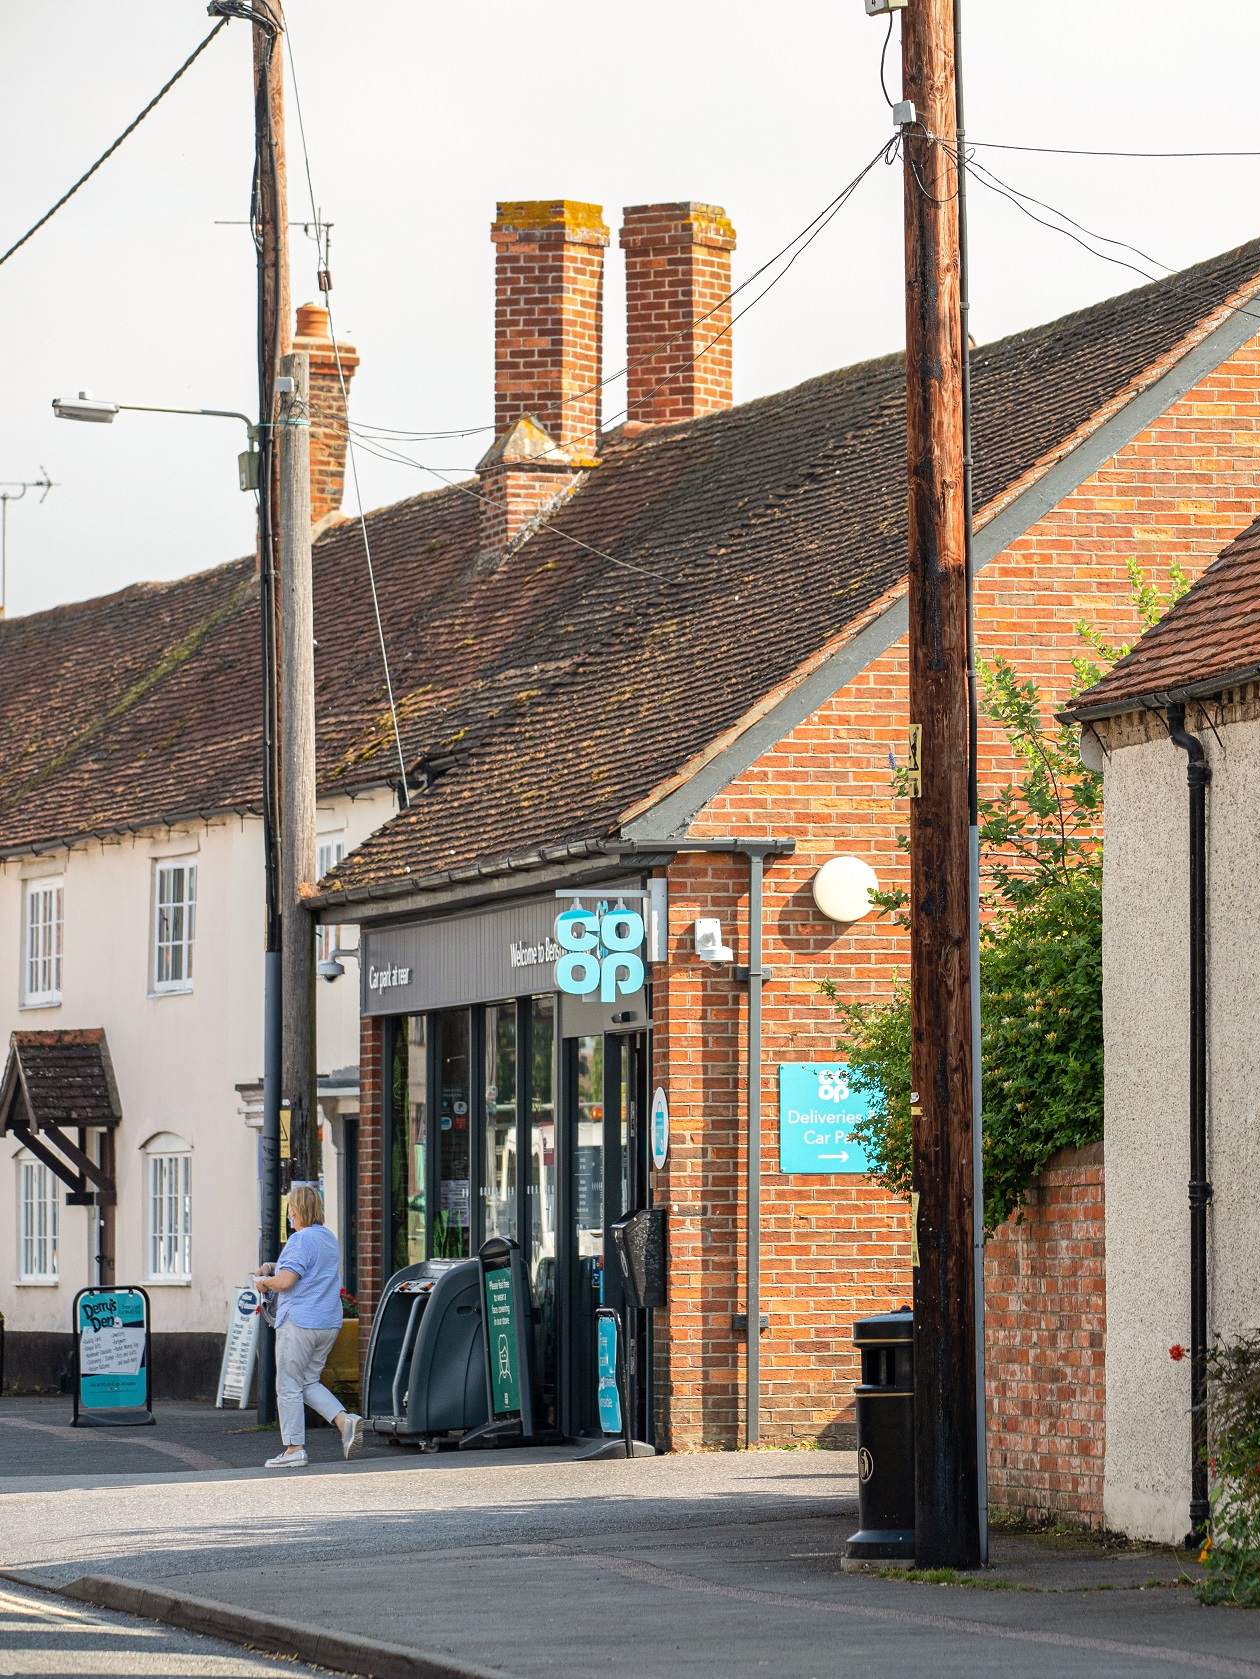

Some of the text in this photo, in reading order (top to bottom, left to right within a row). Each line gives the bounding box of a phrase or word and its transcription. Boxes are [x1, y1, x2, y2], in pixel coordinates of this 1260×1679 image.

[510, 940, 537, 968] Welcome
[537, 941, 545, 963] to
[369, 962, 409, 995] Car park at rear
[788, 1109, 863, 1124] Deliveries
[803, 1130, 831, 1145] Car
[489, 1280, 498, 1290] Please
[81, 1298, 117, 1320] Derry's
[90, 1315, 115, 1333] Den
